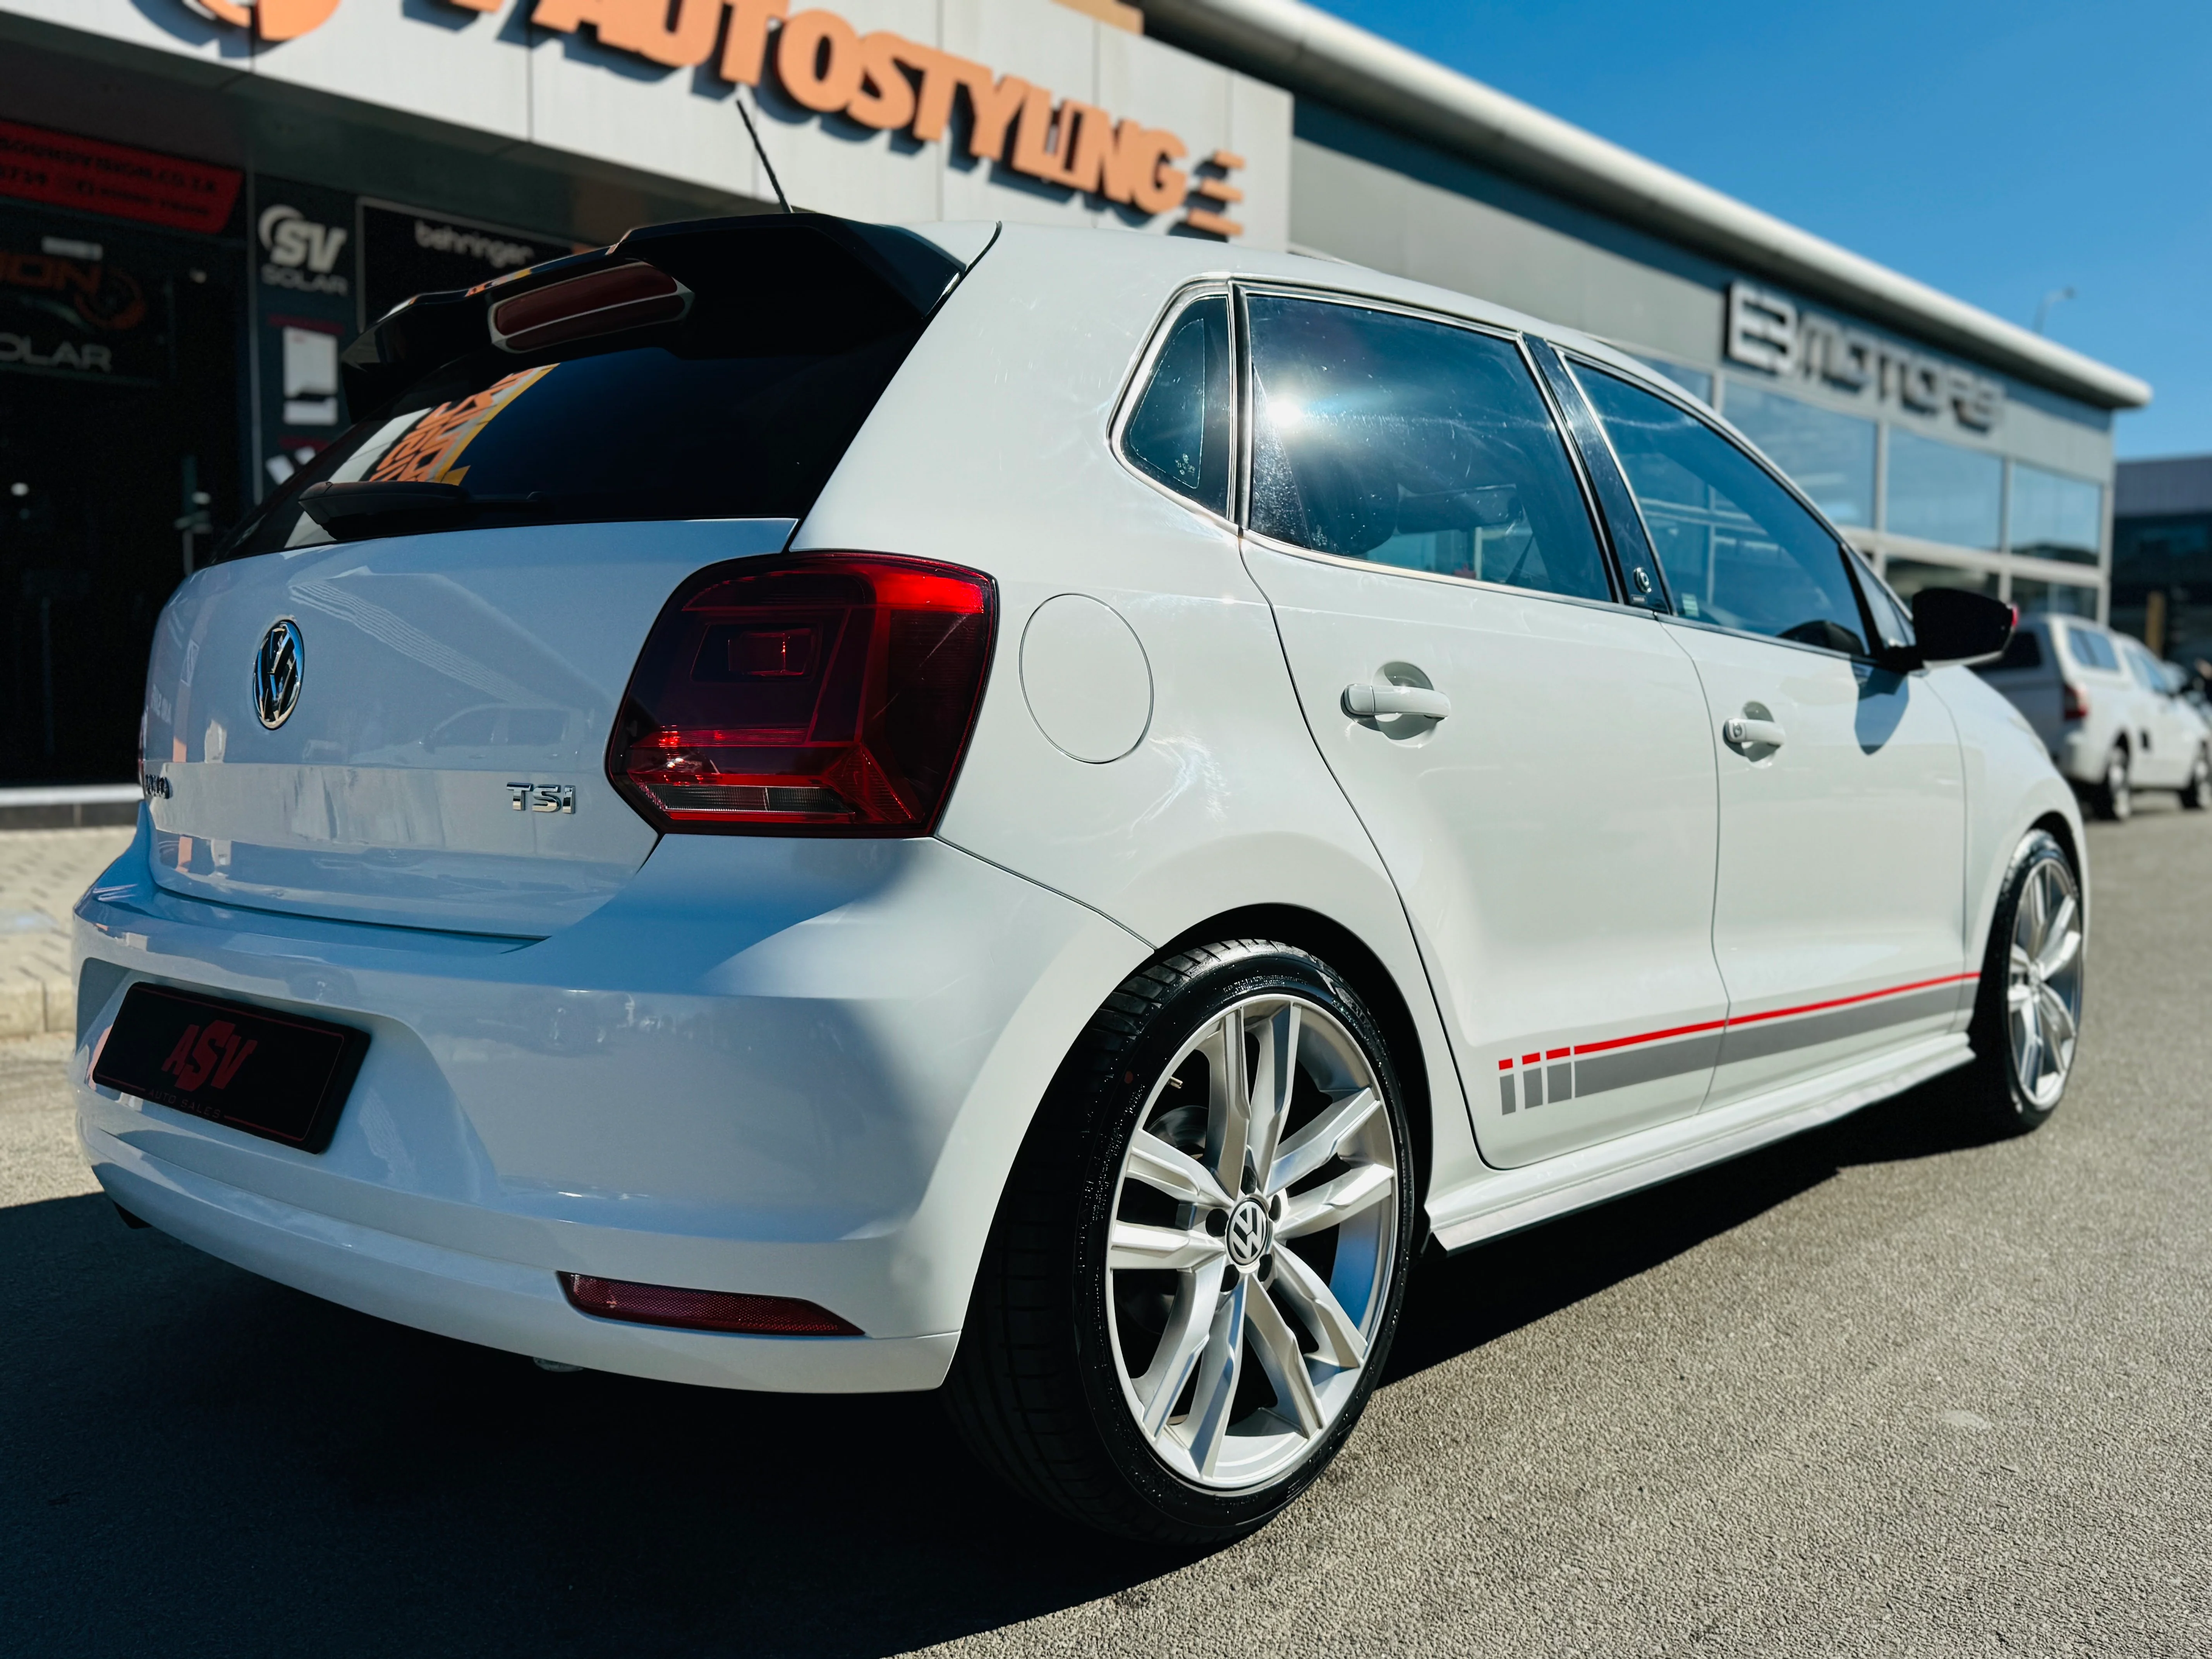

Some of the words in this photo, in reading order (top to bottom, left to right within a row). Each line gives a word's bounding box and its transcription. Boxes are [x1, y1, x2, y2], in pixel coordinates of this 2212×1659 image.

[270, 219, 347, 273] SV
[415, 219, 534, 269] behringer
[261, 264, 348, 297] SOLAR
[506, 782, 576, 814] TSI
[161, 1019, 258, 1092] ASV
[148, 1089, 177, 1104] AUTO
[180, 1099, 221, 1119] SALES
